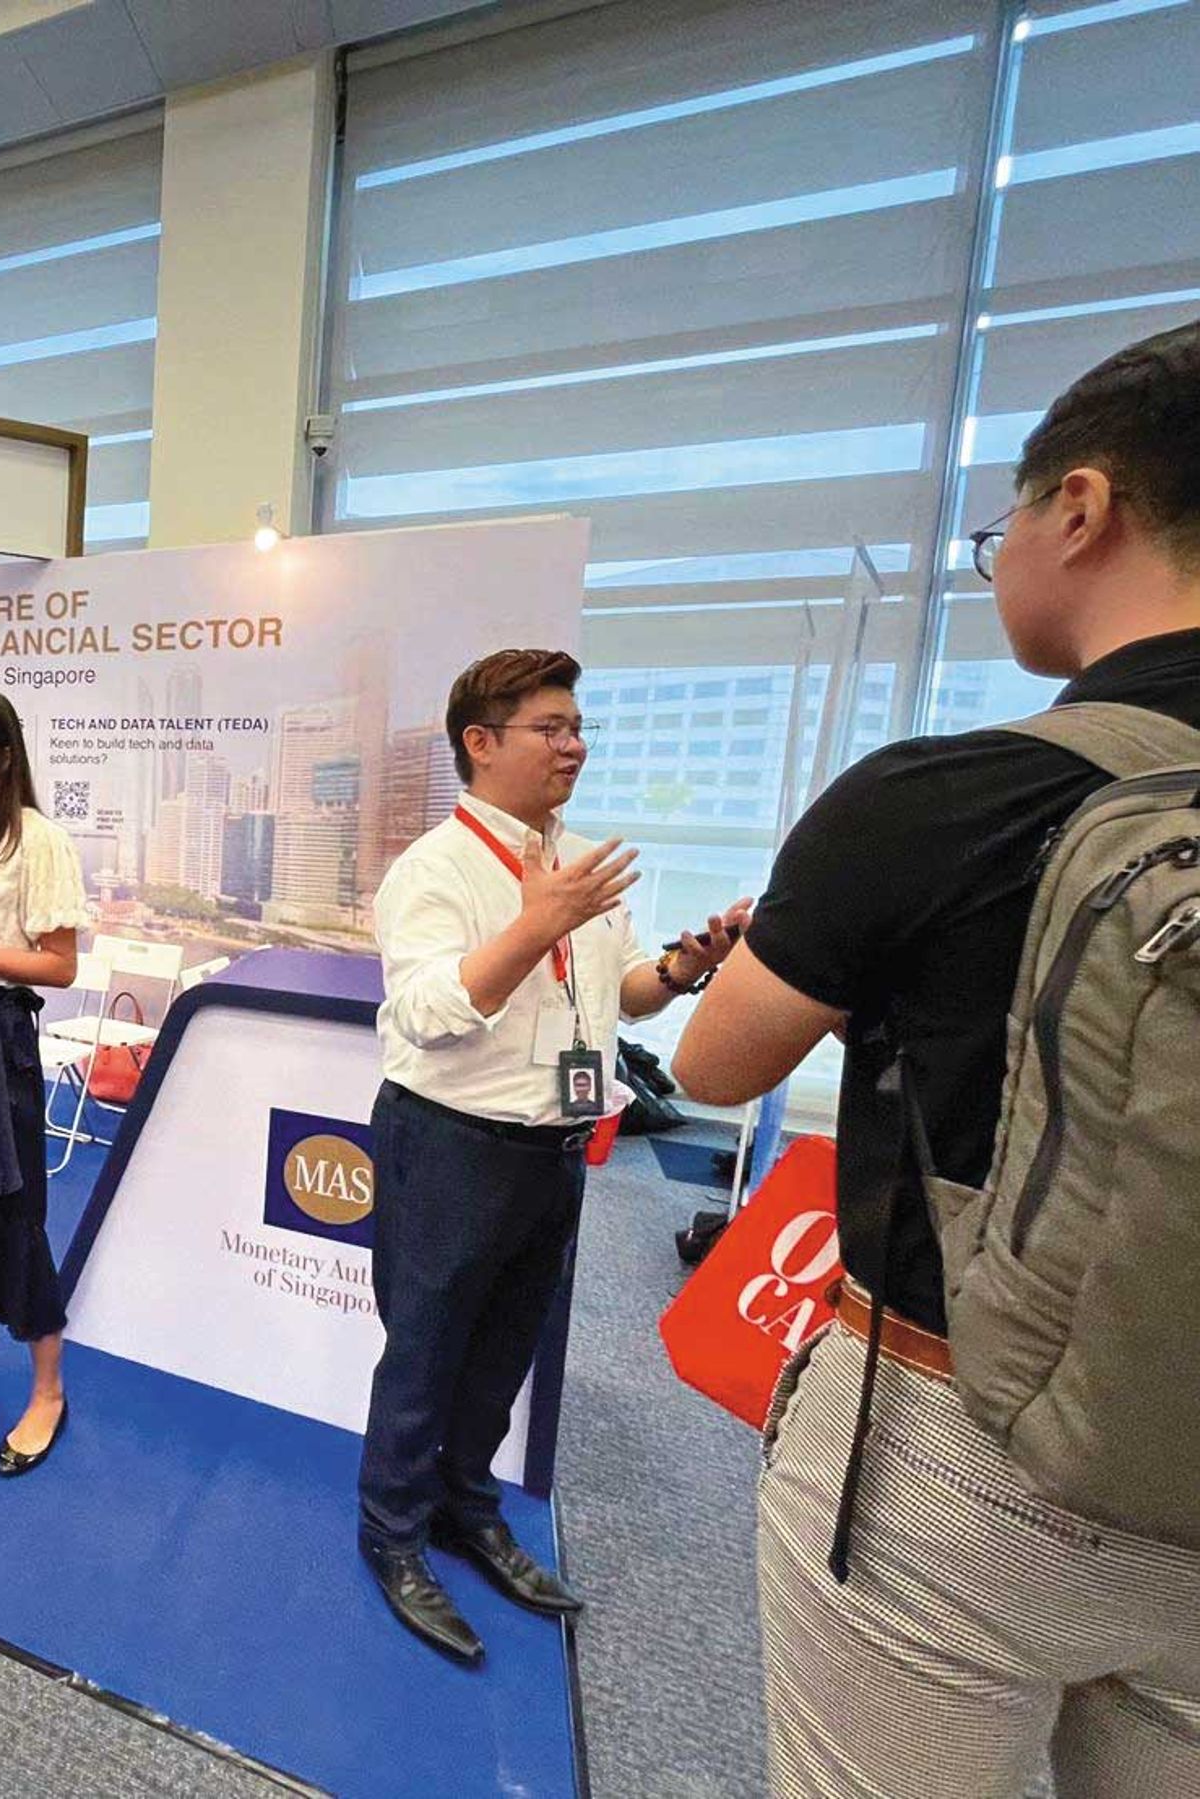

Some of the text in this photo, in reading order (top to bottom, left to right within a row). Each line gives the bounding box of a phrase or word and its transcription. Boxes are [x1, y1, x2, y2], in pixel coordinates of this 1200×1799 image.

[45, 590, 90, 620] OF
[131, 617, 283, 652] SECTOR
[4, 666, 97, 689] Singapore
[51, 717, 269, 732] TECH AND DATA TALENT (TEDA)
[50, 738, 214, 751] Keen to build tech and data
[49, 754, 108, 765] solutions?
[294, 1155, 371, 1204] MAS
[220, 1229, 373, 1287] Monetary Aut
[253, 1269, 277, 1288] of
